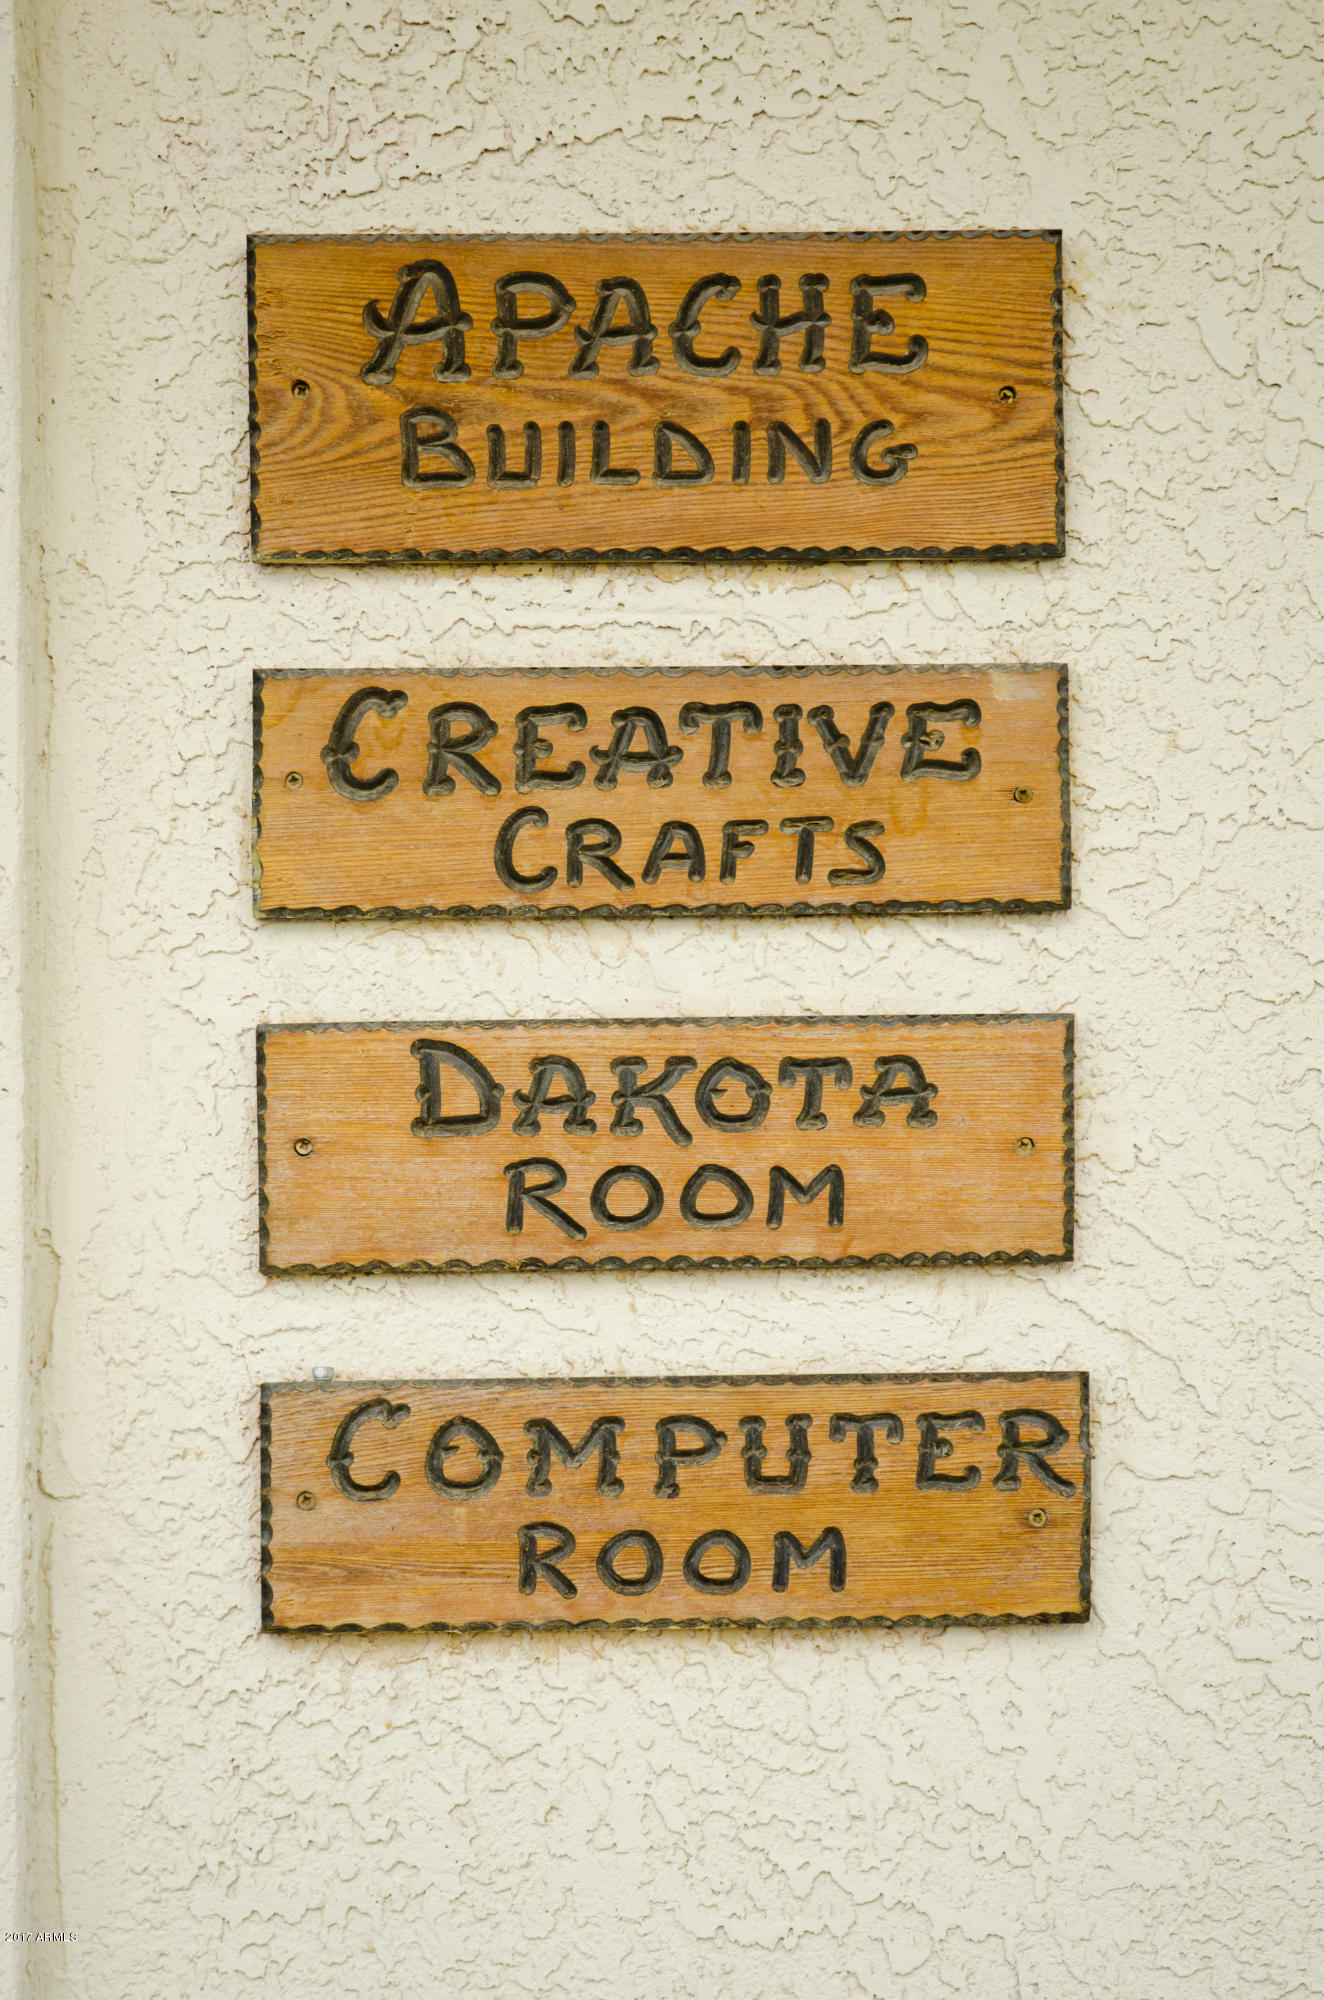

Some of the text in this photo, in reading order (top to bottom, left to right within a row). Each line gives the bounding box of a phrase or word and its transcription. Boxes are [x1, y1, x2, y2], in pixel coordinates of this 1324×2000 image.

[361, 259, 928, 384] APACHE
[400, 406, 918, 488] BUILDING
[320, 686, 982, 802] CREATIVE
[493, 806, 887, 893] CRAFTS
[410, 1038, 940, 1147] DAKOTA
[503, 1157, 845, 1241] ROOM
[328, 1398, 1077, 1501] COMPUTER
[518, 1520, 847, 1599] ROOM
